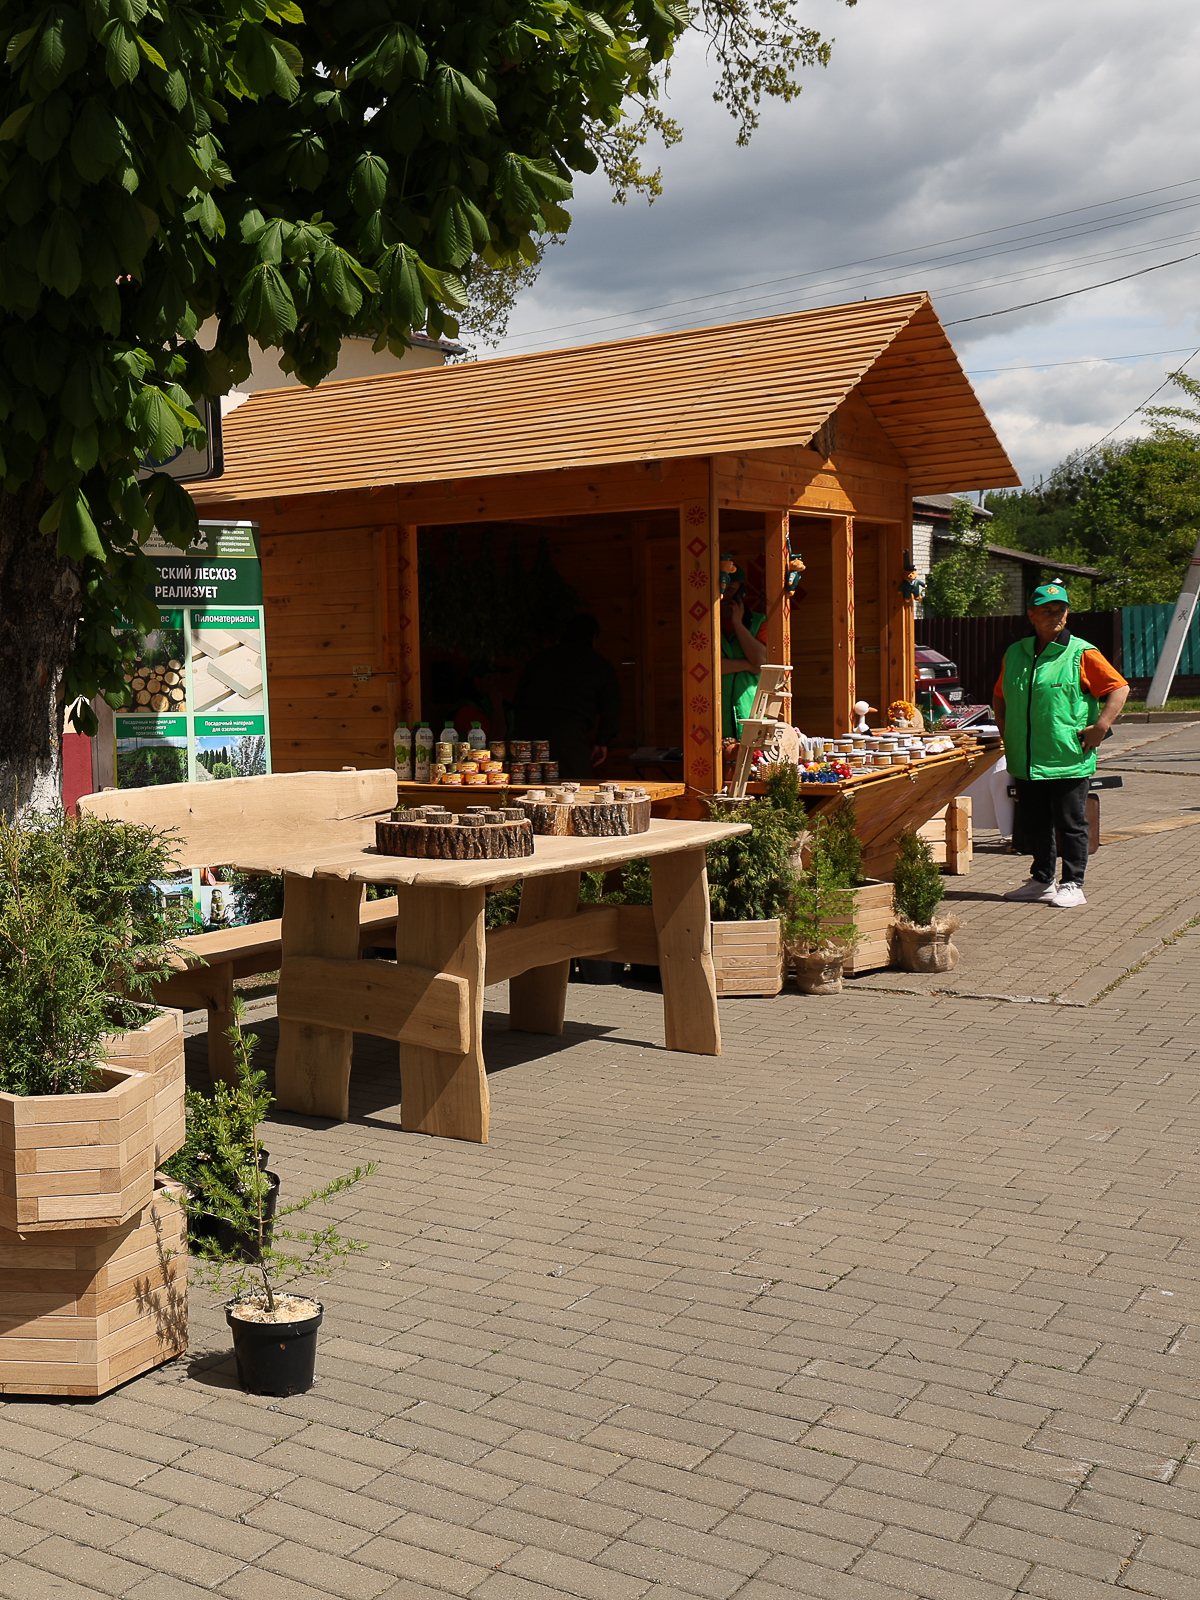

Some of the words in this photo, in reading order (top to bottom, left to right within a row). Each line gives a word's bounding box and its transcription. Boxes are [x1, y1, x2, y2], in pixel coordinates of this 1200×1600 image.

[194, 567, 237, 580] ЛЕСХОЗ
[154, 585, 218, 599] РЕАЛИЗУЕТ
[194, 613, 256, 625] Пиломатериалы
